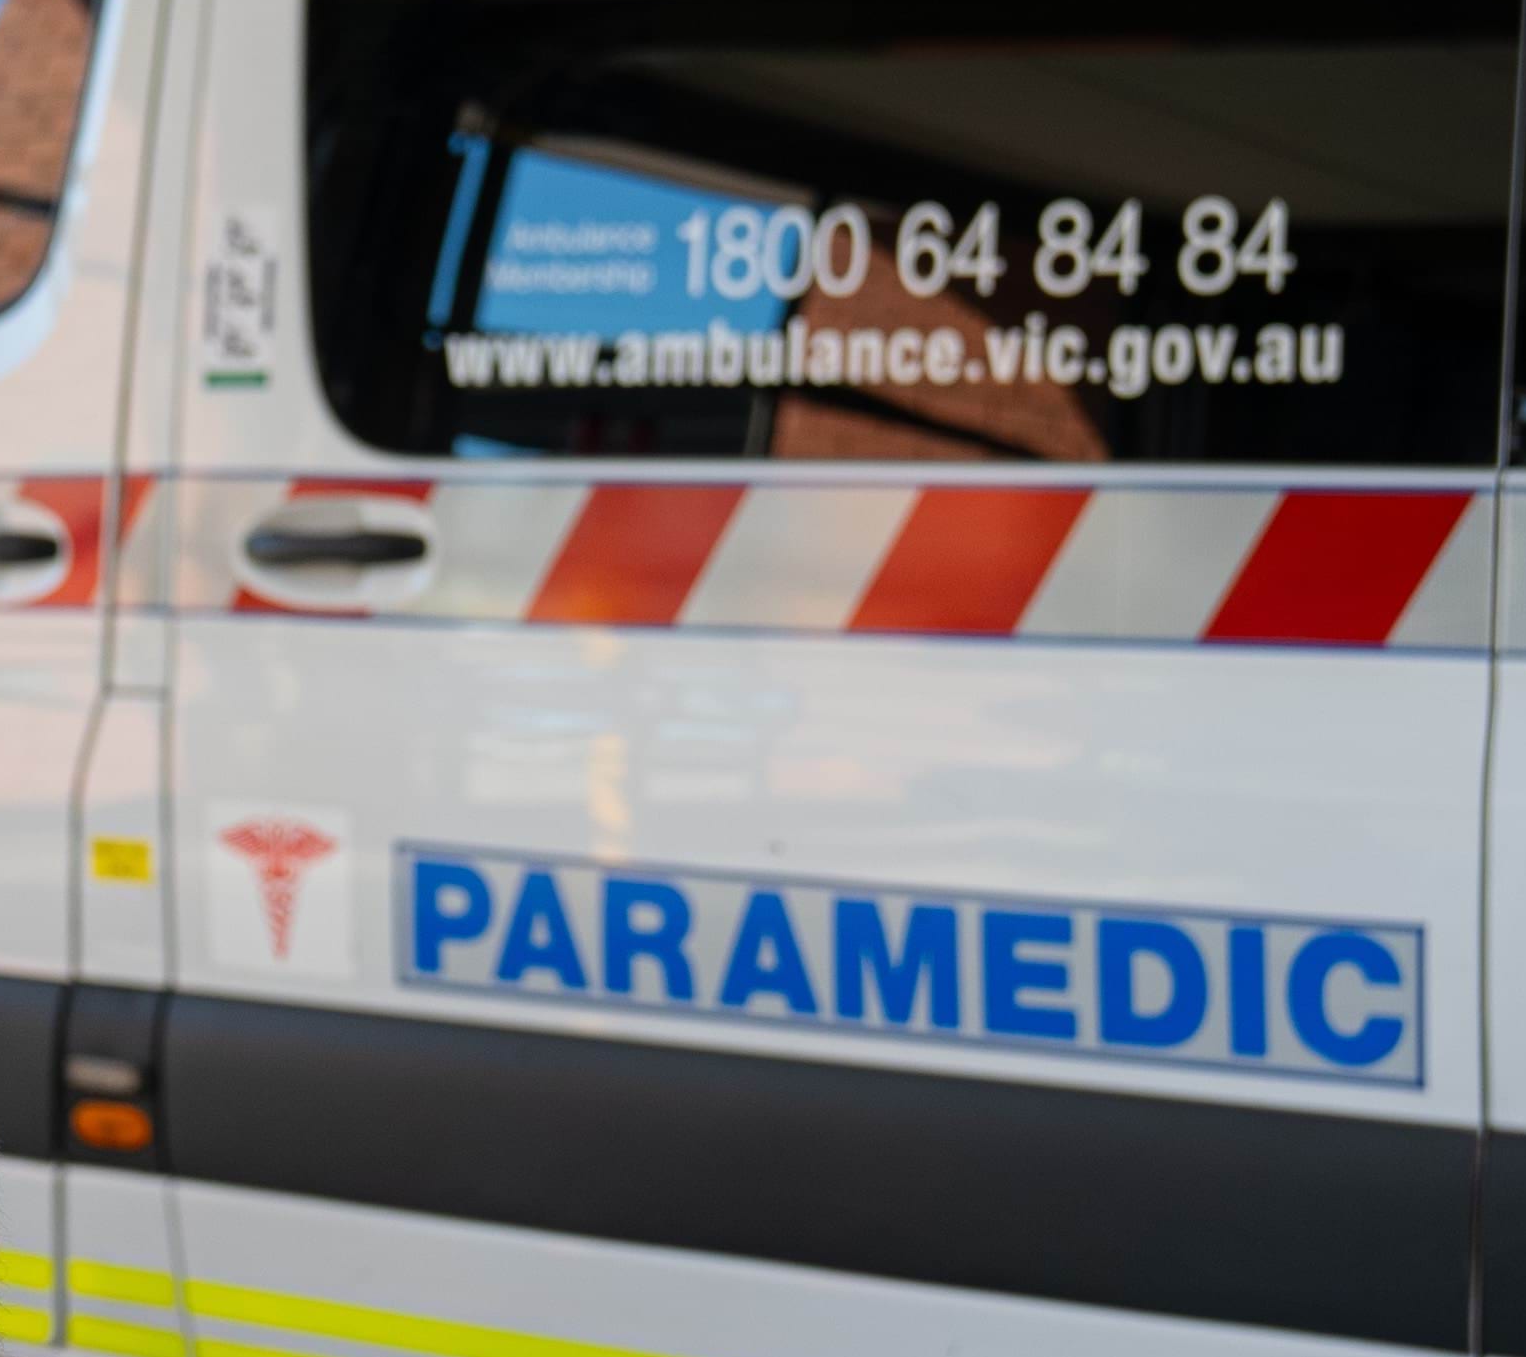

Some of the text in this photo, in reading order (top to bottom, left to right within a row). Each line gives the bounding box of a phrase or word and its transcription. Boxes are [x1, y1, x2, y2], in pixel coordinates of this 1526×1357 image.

[677, 195, 1297, 300] 1800 64 84 84
[444, 311, 1344, 399] www.ambulance.vic.gov.au
[412, 859, 1406, 1068] PARAMEDIC
